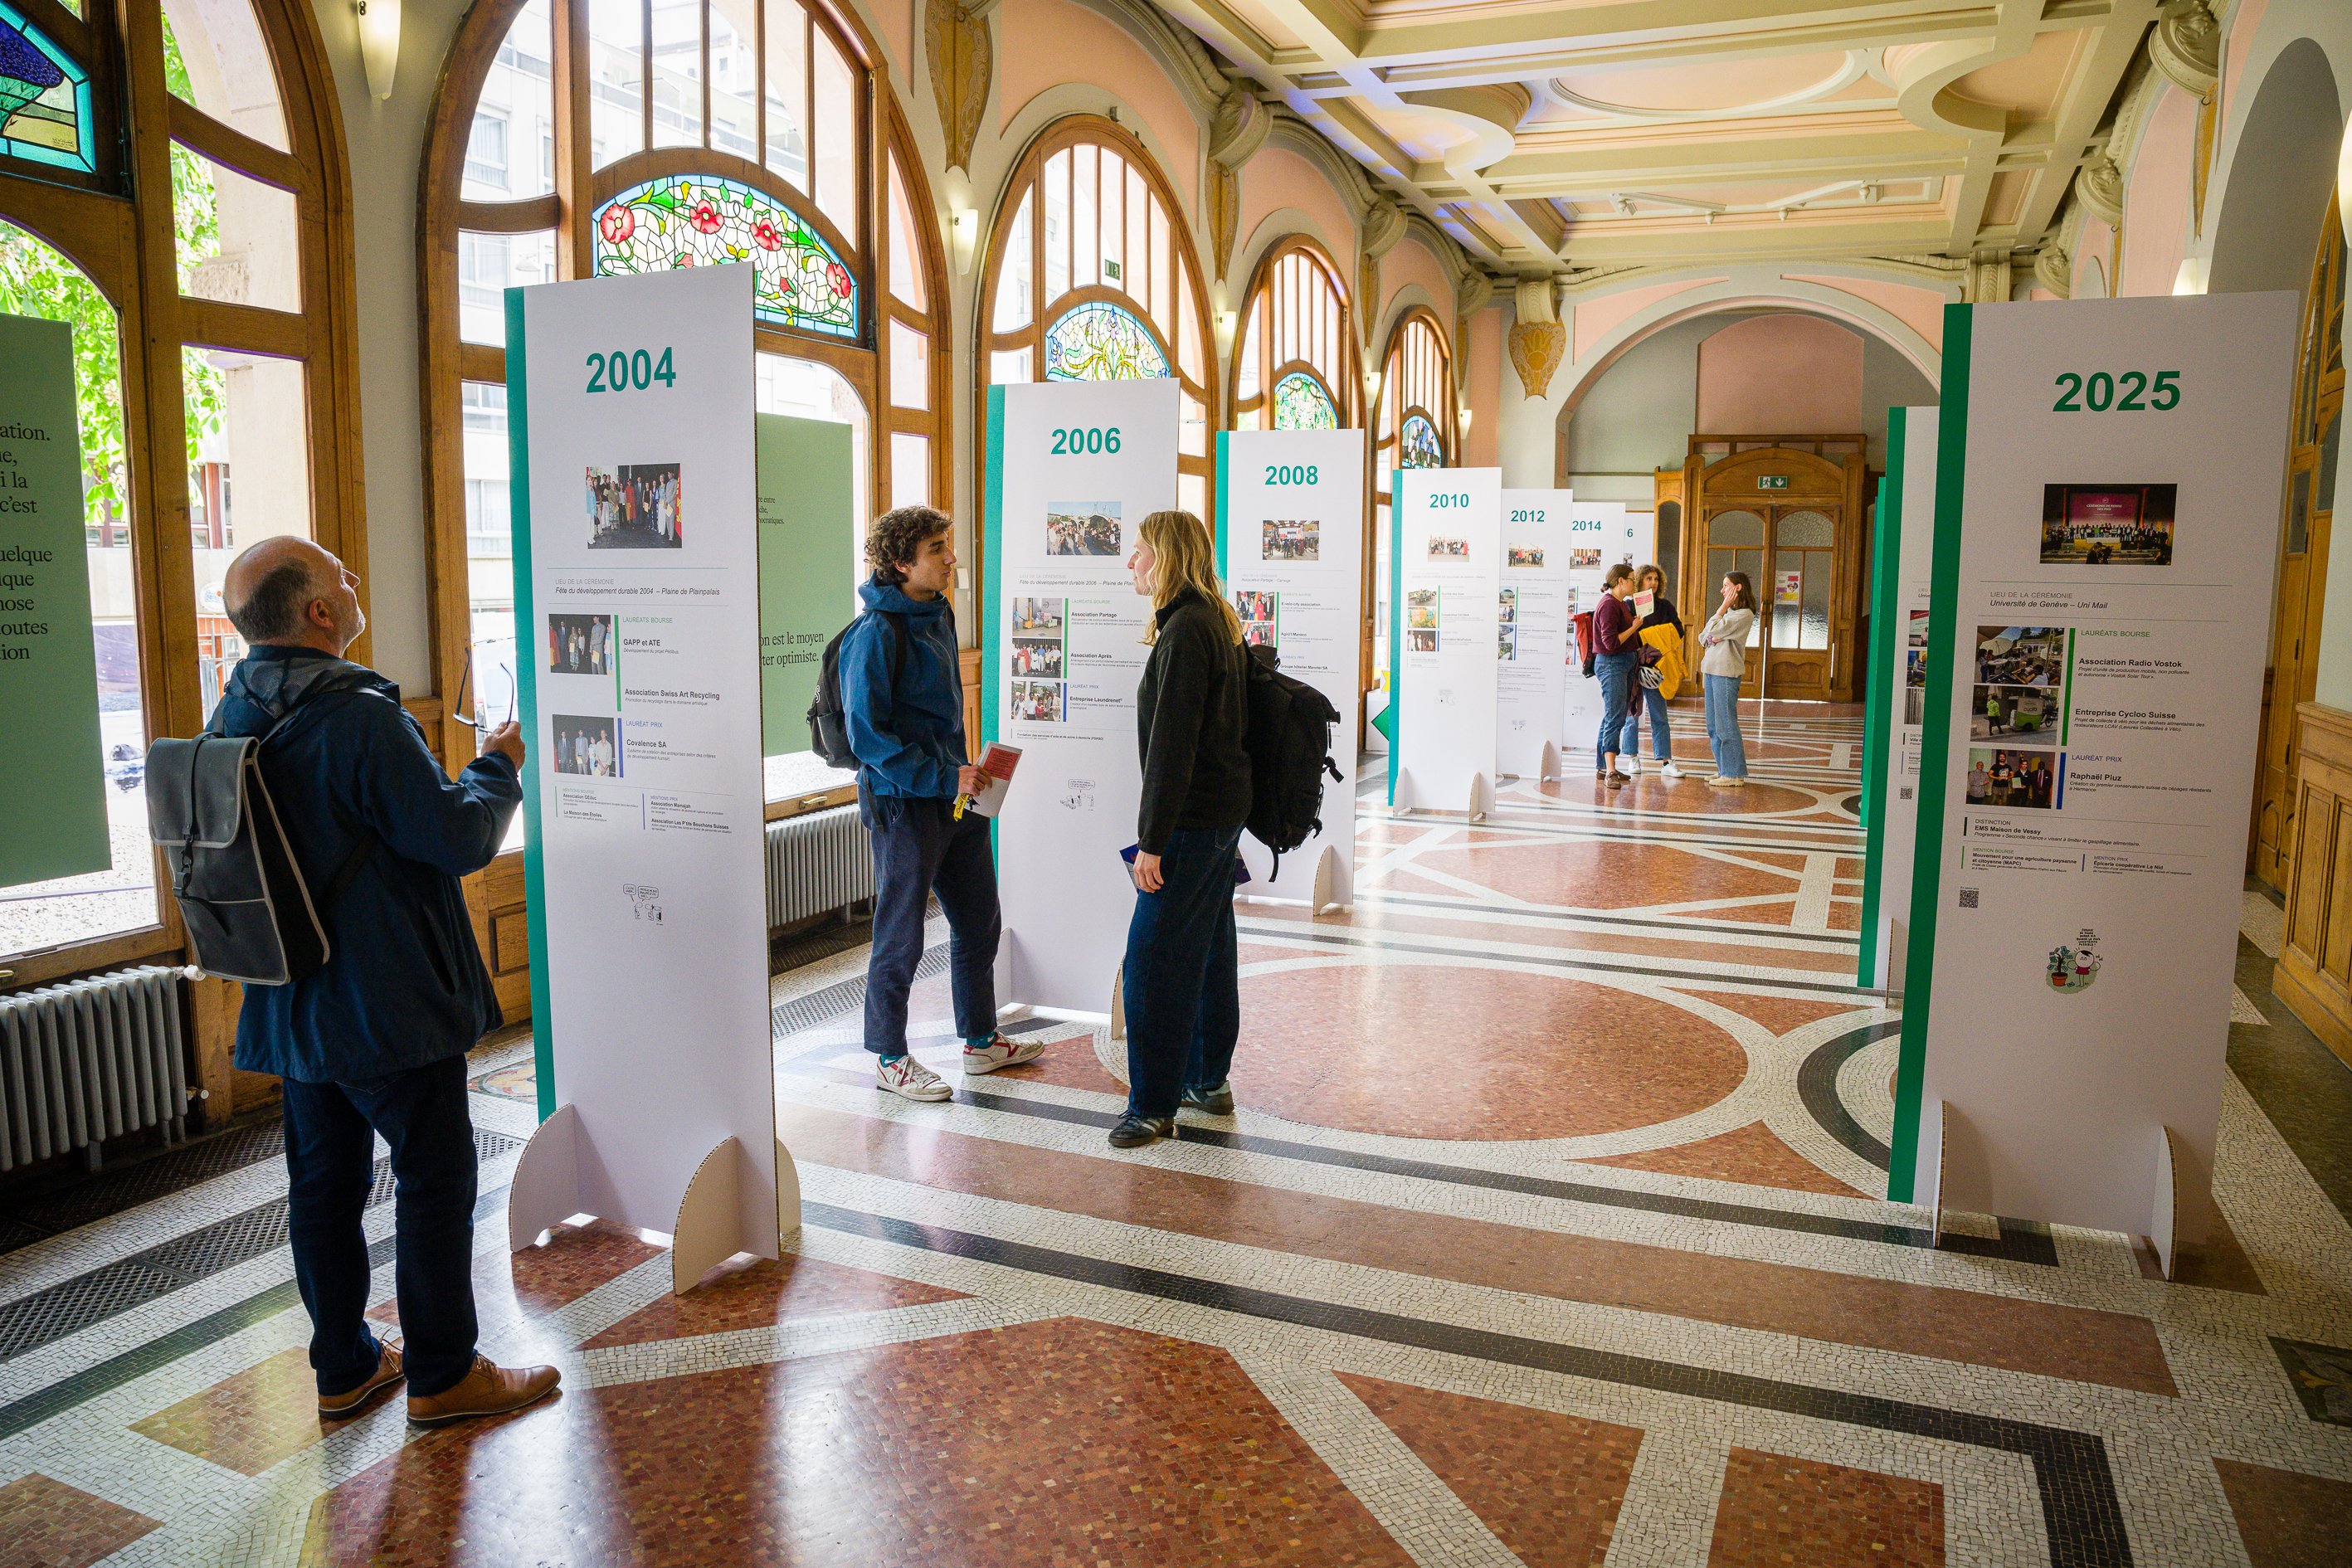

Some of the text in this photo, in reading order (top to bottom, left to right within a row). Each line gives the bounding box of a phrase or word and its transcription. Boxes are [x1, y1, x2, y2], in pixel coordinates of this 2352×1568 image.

[586, 347, 676, 393] 2004
[2053, 371, 2181, 412] 2025
[1051, 427, 1121, 455] 2006
[11, 471, 29, 488] la
[1265, 465, 1319, 485] 2008
[0, 496, 38, 513] c’est
[1429, 494, 1469, 508] 2010
[1511, 510, 1545, 523] 2012
[1572, 520, 1602, 531] 2014
[576, 588, 616, 596] développement
[689, 588, 720, 597] Plainpalais
[772, 635, 785, 645] est
[787, 631, 794, 644] le
[796, 633, 824, 646] moyen
[777, 650, 819, 667] optimiste.
[690, 691, 720, 701] Recycling
[2075, 709, 2116, 717] Entreprise
[2070, 773, 2102, 781] Raphaël
